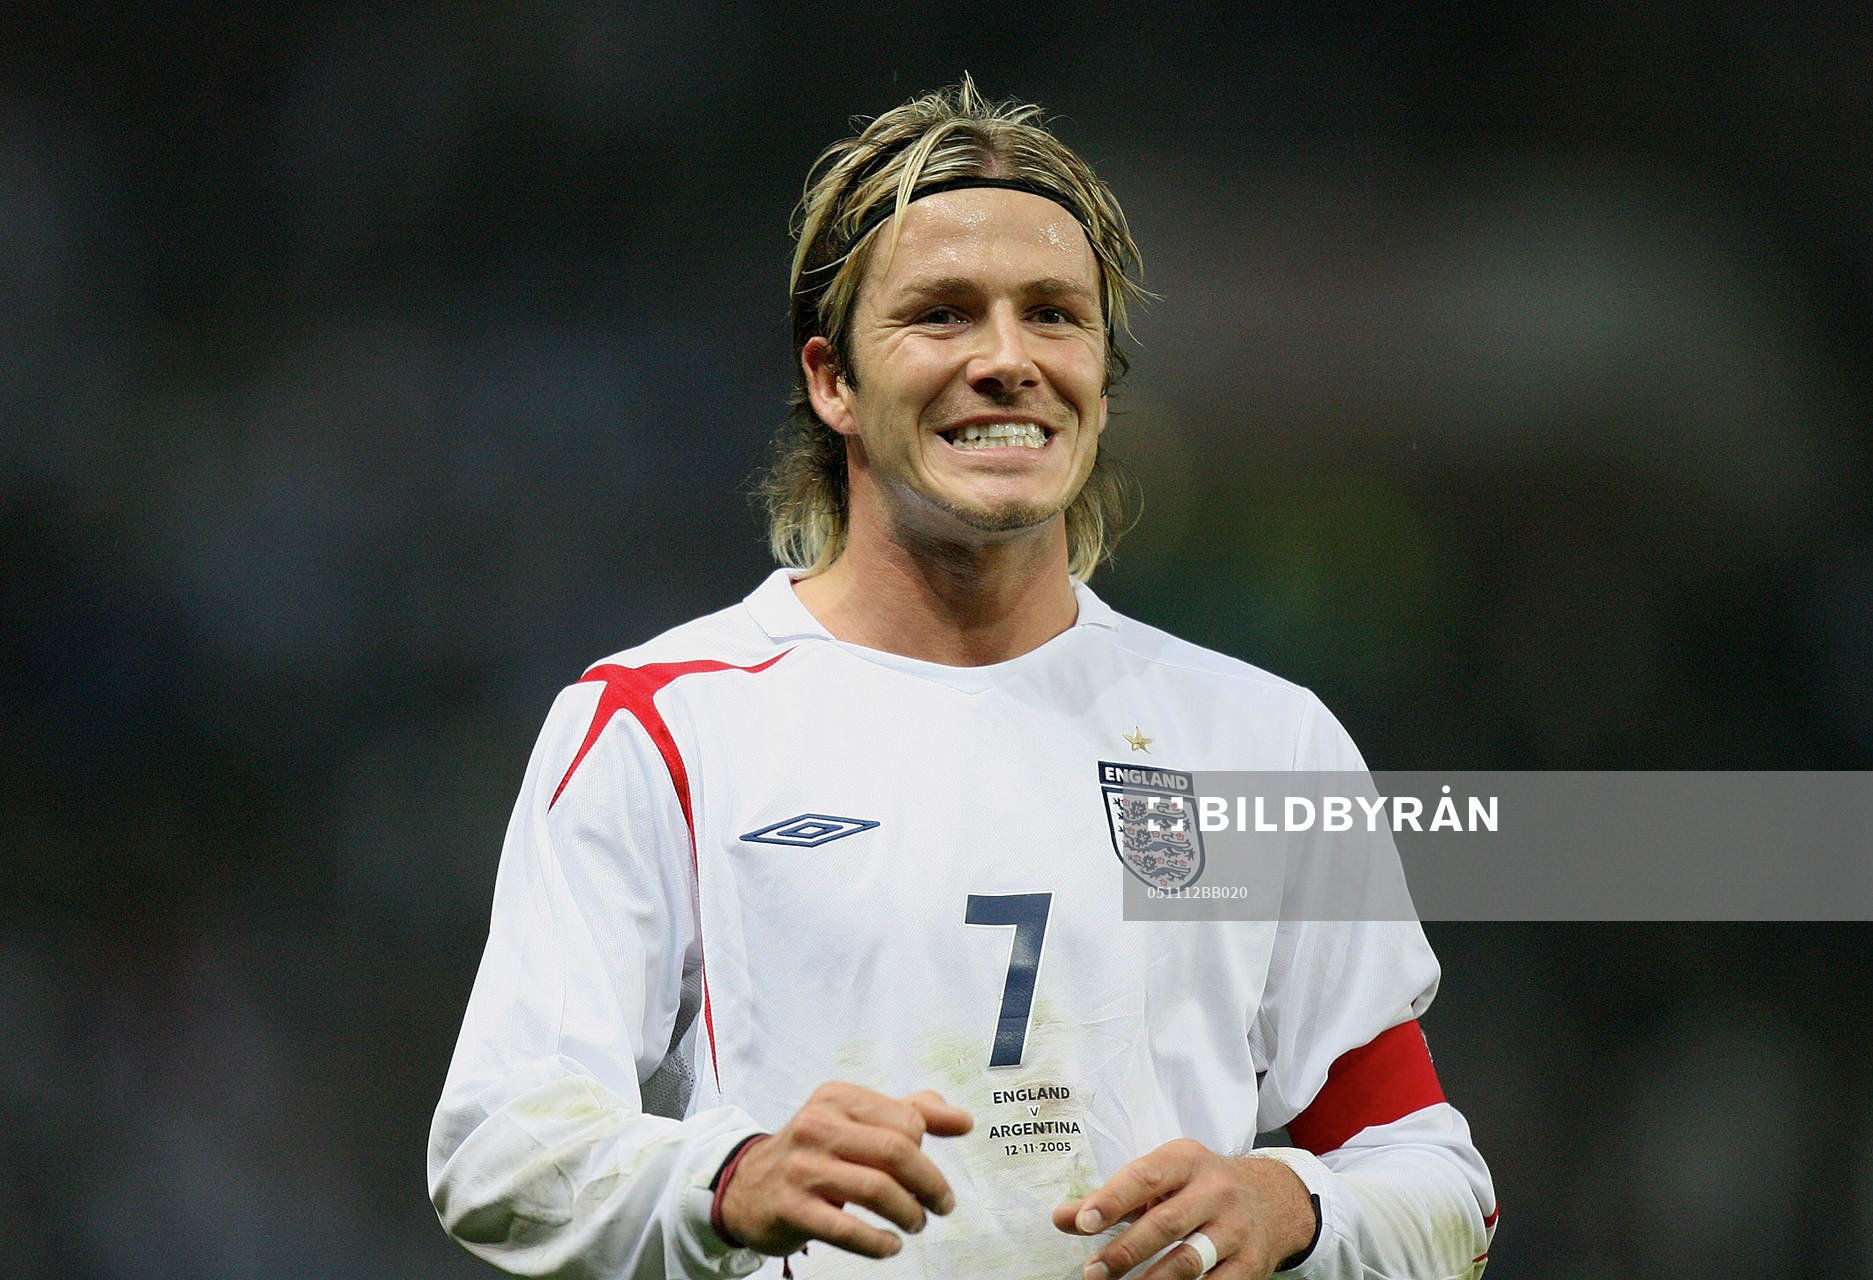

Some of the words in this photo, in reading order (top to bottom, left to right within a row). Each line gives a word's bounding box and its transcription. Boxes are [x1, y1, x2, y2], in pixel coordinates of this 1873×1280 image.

[1104, 767, 1188, 790] ENGLAND
[964, 892, 1053, 1067] 7
[992, 1087, 1070, 1104] ENGLAND
[989, 1121, 1081, 1139] ARGENTINA
